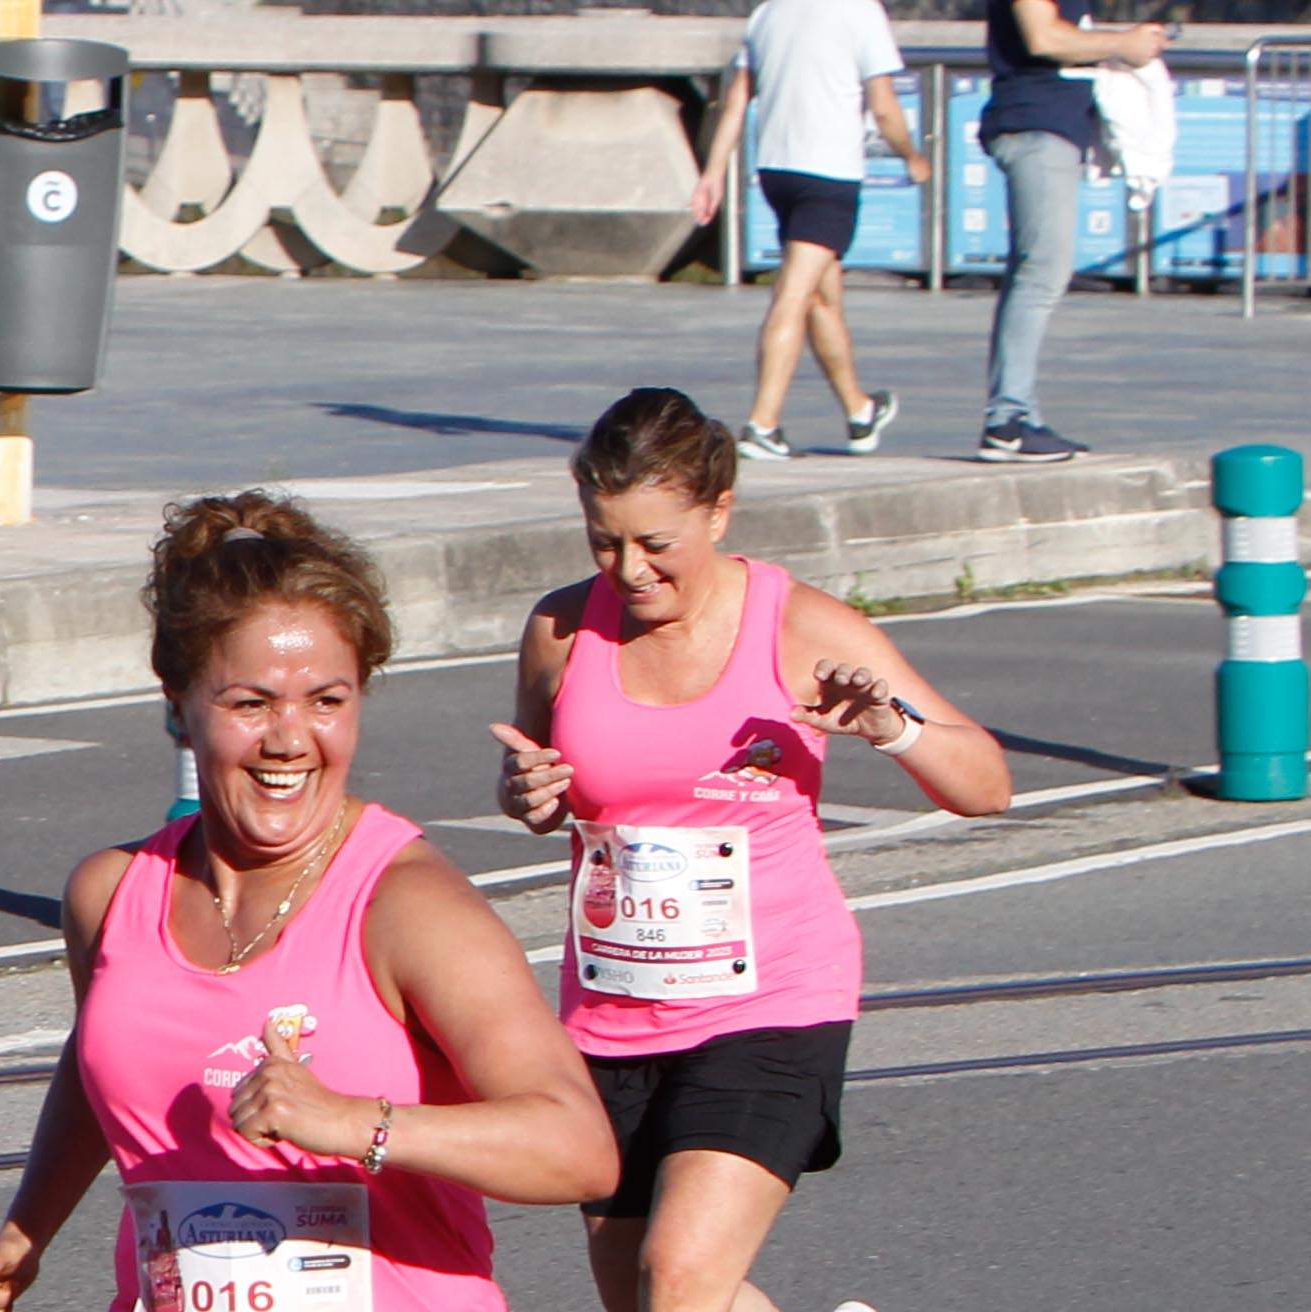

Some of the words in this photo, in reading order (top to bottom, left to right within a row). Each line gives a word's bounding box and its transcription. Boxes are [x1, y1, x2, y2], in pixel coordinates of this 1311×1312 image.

[739, 790, 748, 801] Y
[621, 896, 680, 919] 016
[296, 1213, 348, 1228] SUMA
[191, 1280, 275, 1312] 016
